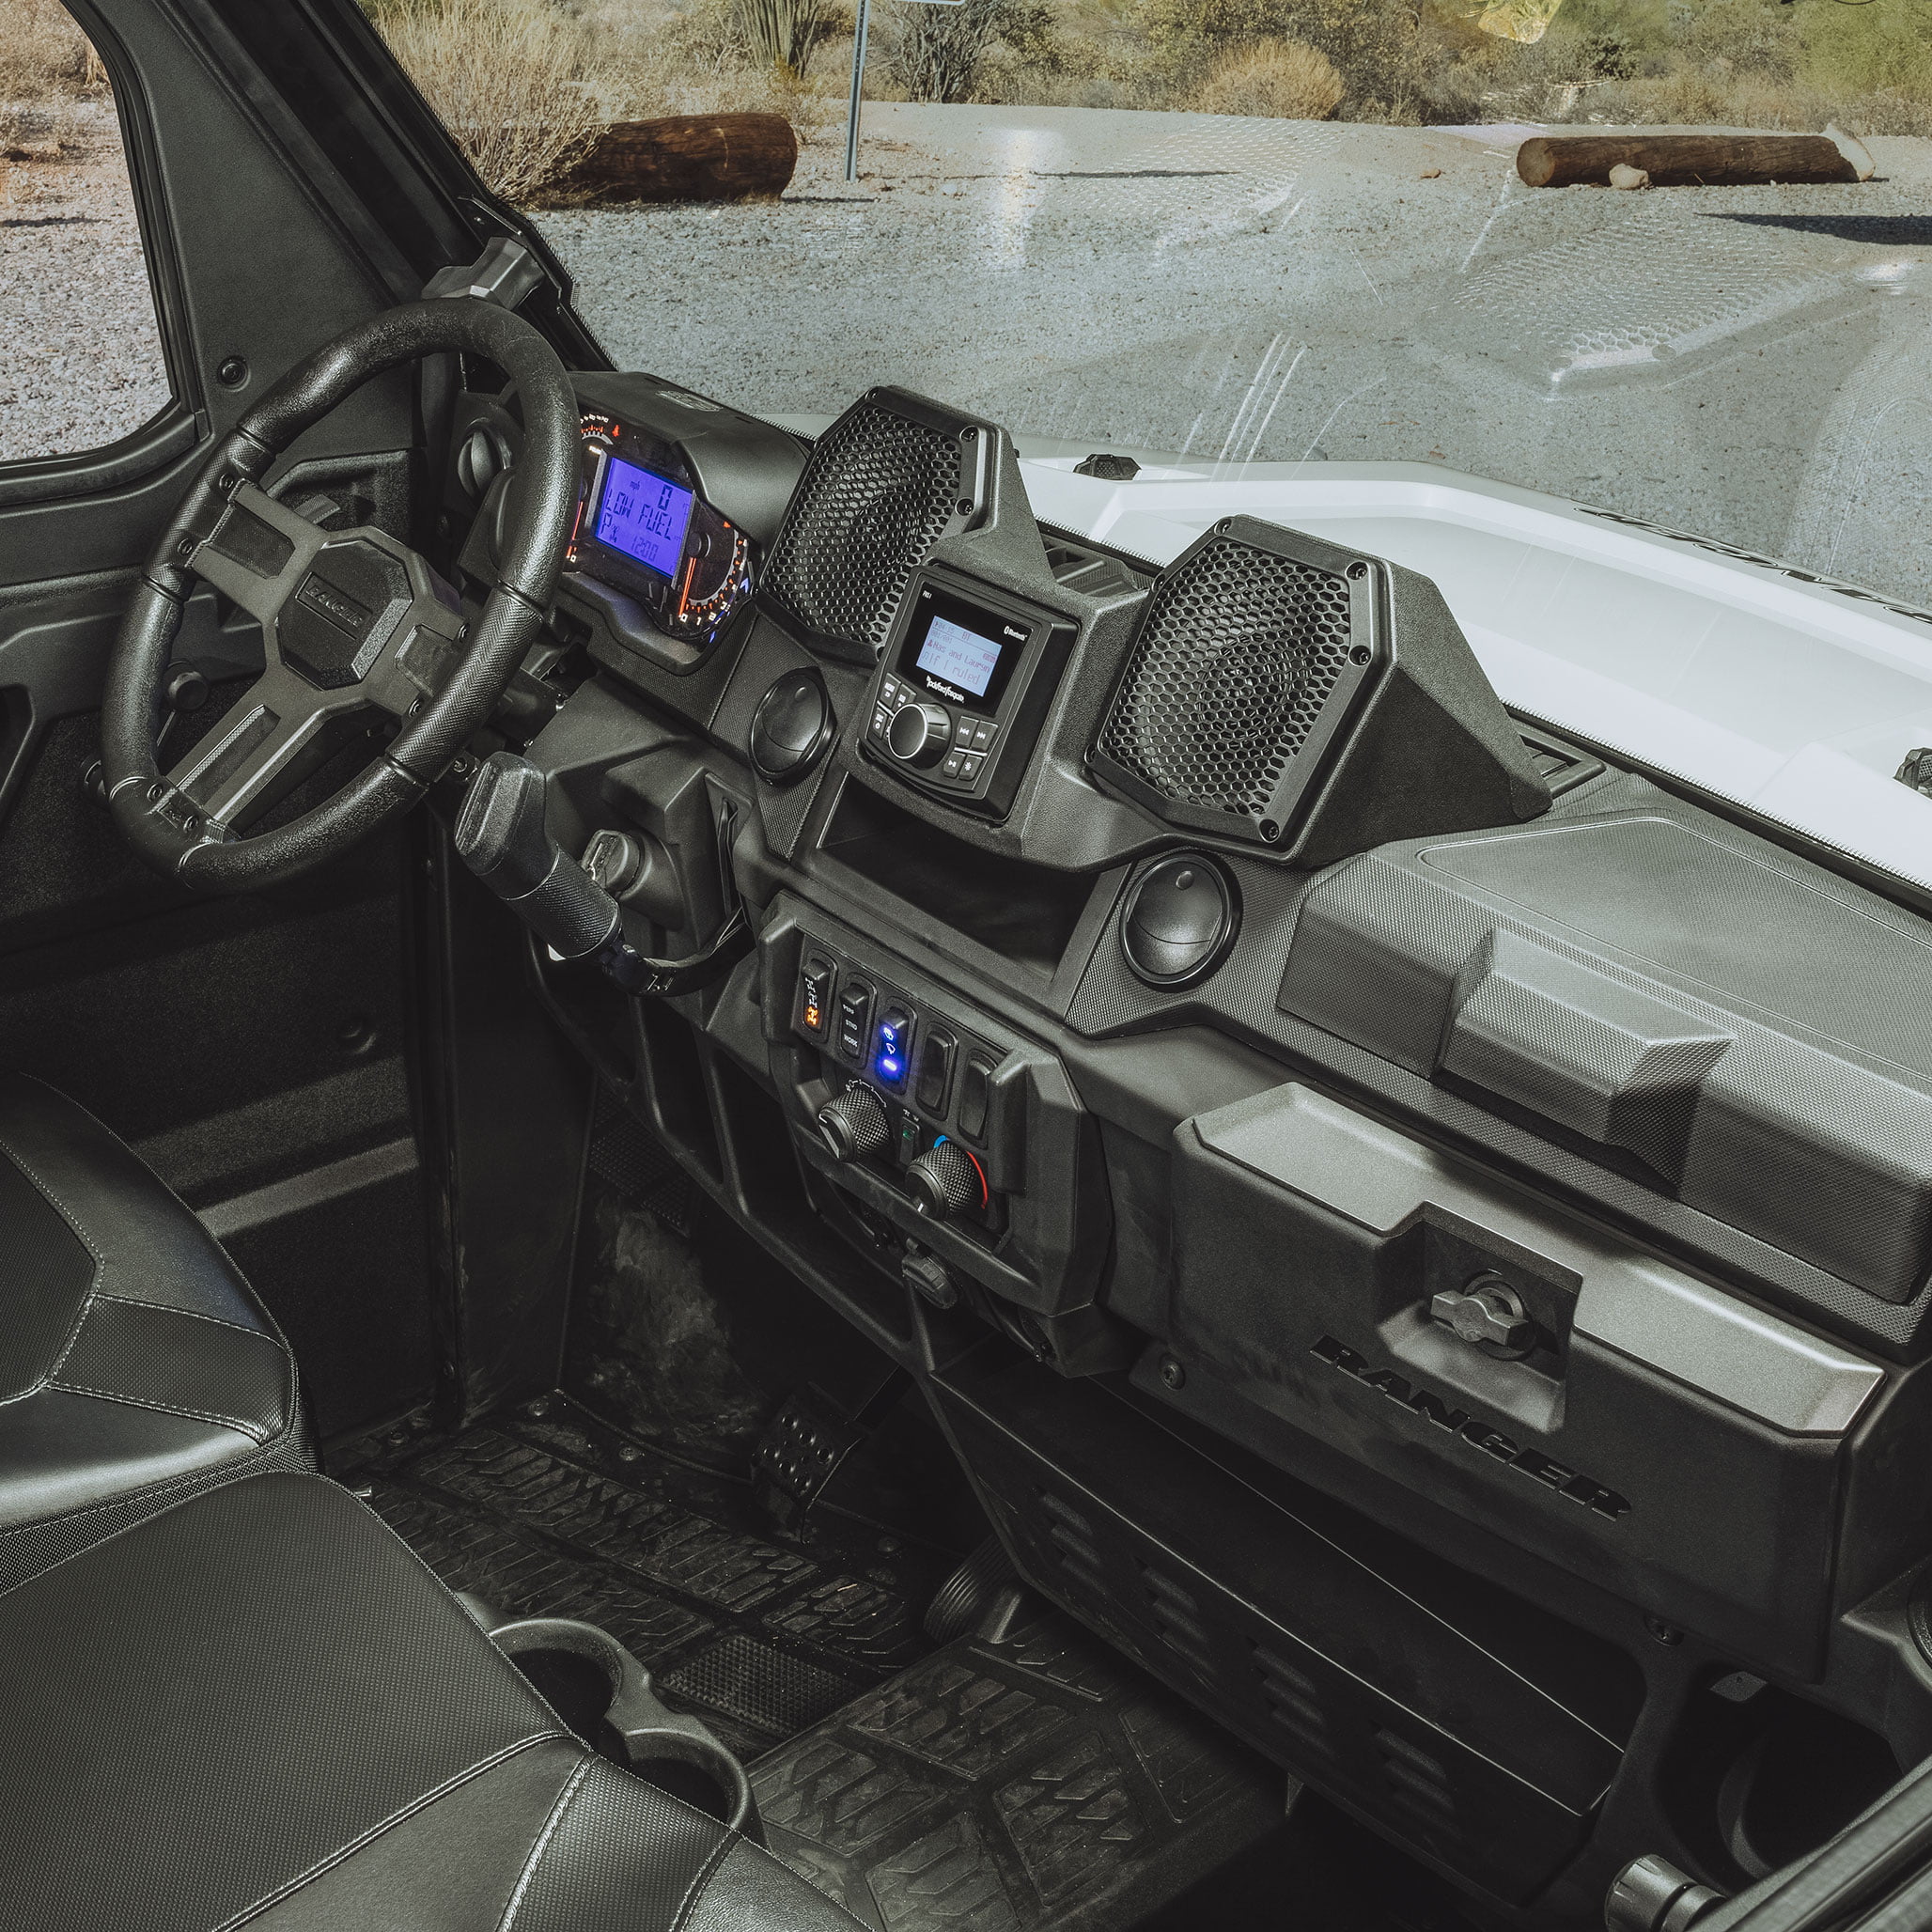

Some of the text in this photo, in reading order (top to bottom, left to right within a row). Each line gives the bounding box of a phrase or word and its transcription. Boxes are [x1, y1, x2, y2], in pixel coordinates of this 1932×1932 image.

[658, 484, 673, 511] 0
[601, 512, 613, 534] P
[606, 488, 672, 540] LOW FUEL
[631, 536, 659, 562] 12:00
[949, 649, 962, 661] and
[952, 666, 980, 685] ruled
[1309, 1333, 1632, 1521] RANGER
